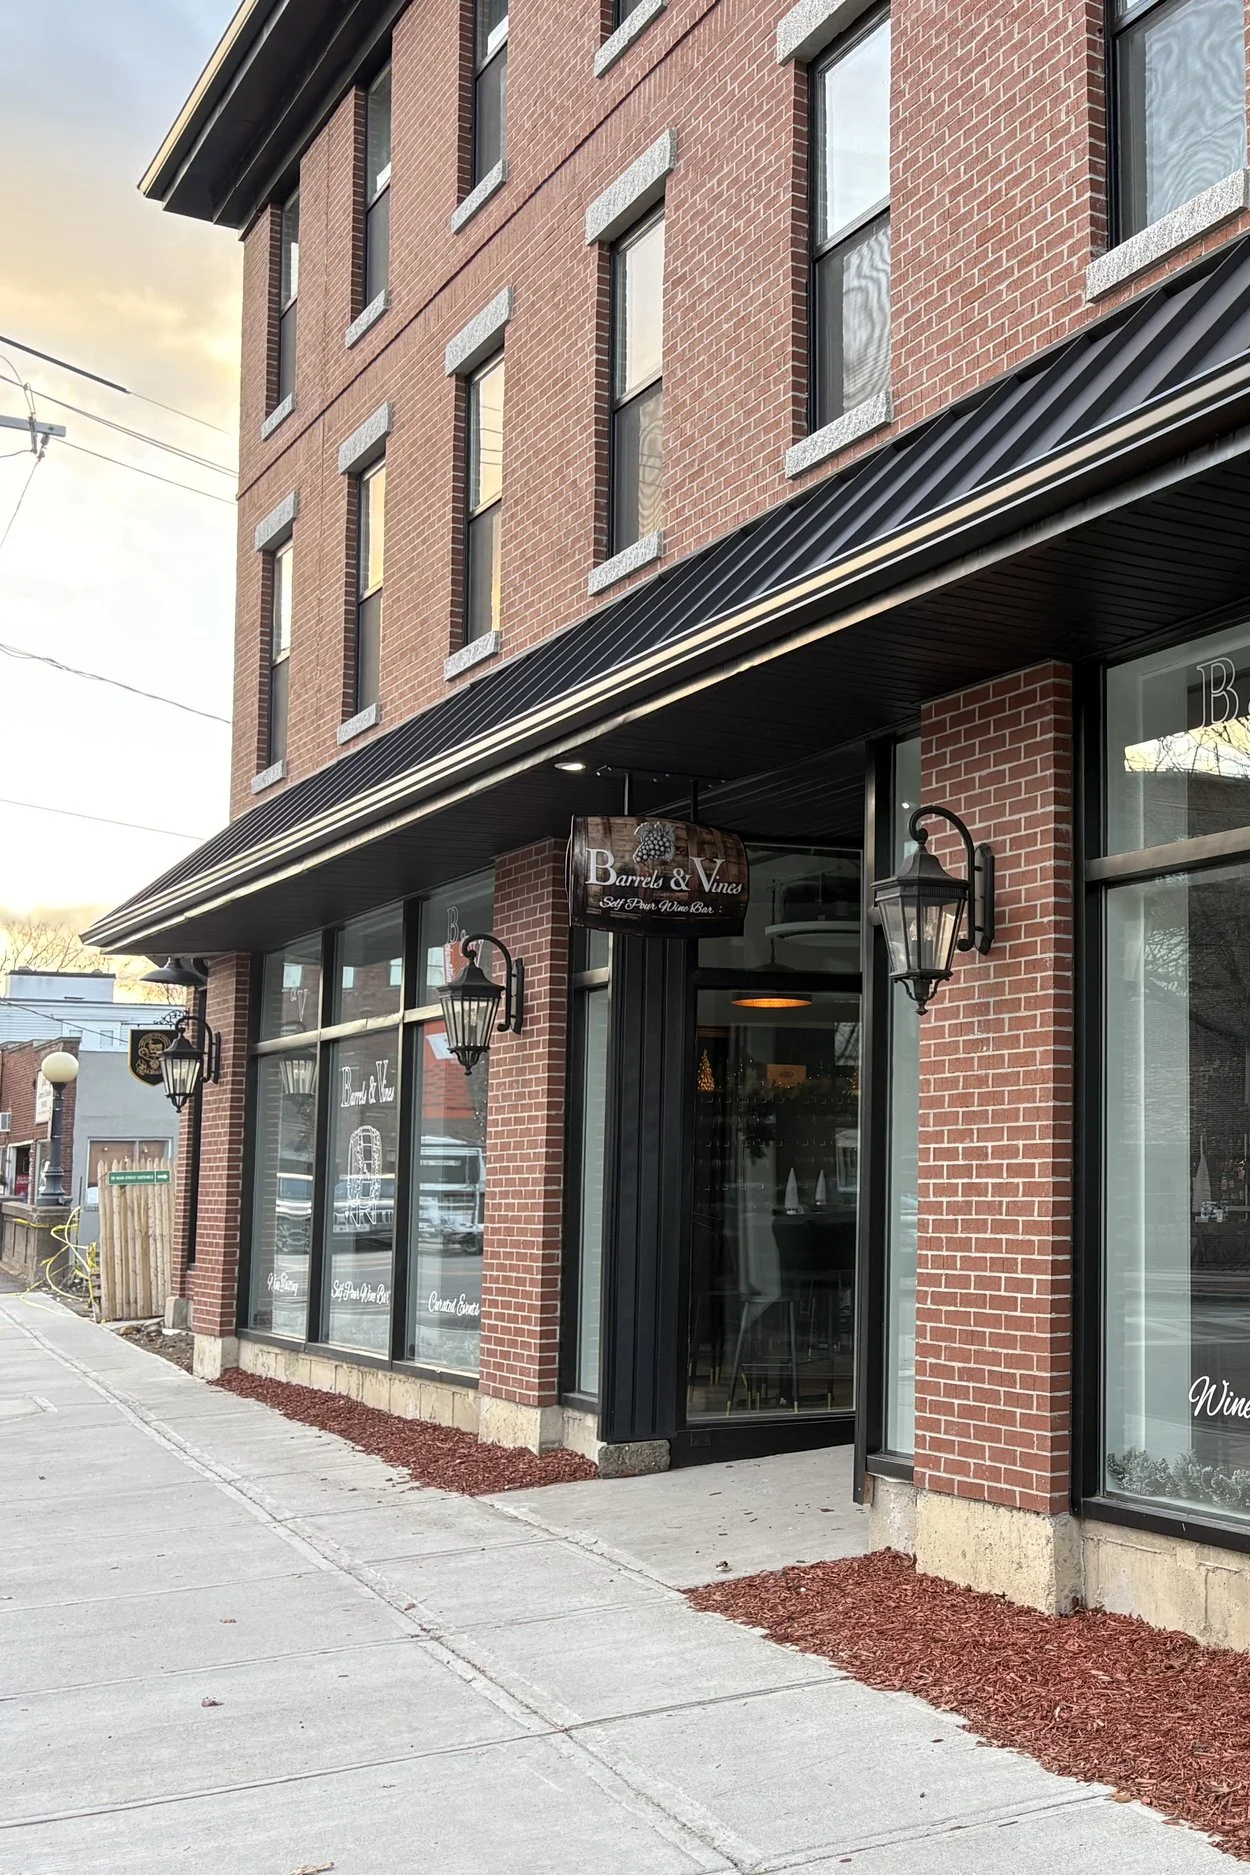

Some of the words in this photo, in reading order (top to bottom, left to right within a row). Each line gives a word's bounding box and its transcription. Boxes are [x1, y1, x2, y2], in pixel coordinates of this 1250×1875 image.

[1196, 657, 1239, 729] B
[585, 847, 664, 888] Barrels
[670, 867, 693, 891] &
[690, 856, 743, 894] Vines
[600, 896, 626, 910] Self
[625, 897, 657, 911] Pour
[658, 899, 689, 913] Wine
[689, 901, 714, 914] Bar
[447, 906, 459, 944] B
[341, 1066, 367, 1107] Barrels
[368, 1075, 377, 1104] &
[376, 1060, 395, 1103] Vines
[331, 1280, 344, 1302] Self
[343, 1281, 360, 1302] Pour
[428, 1290, 457, 1313] Curated
[456, 1293, 480, 1316] Events
